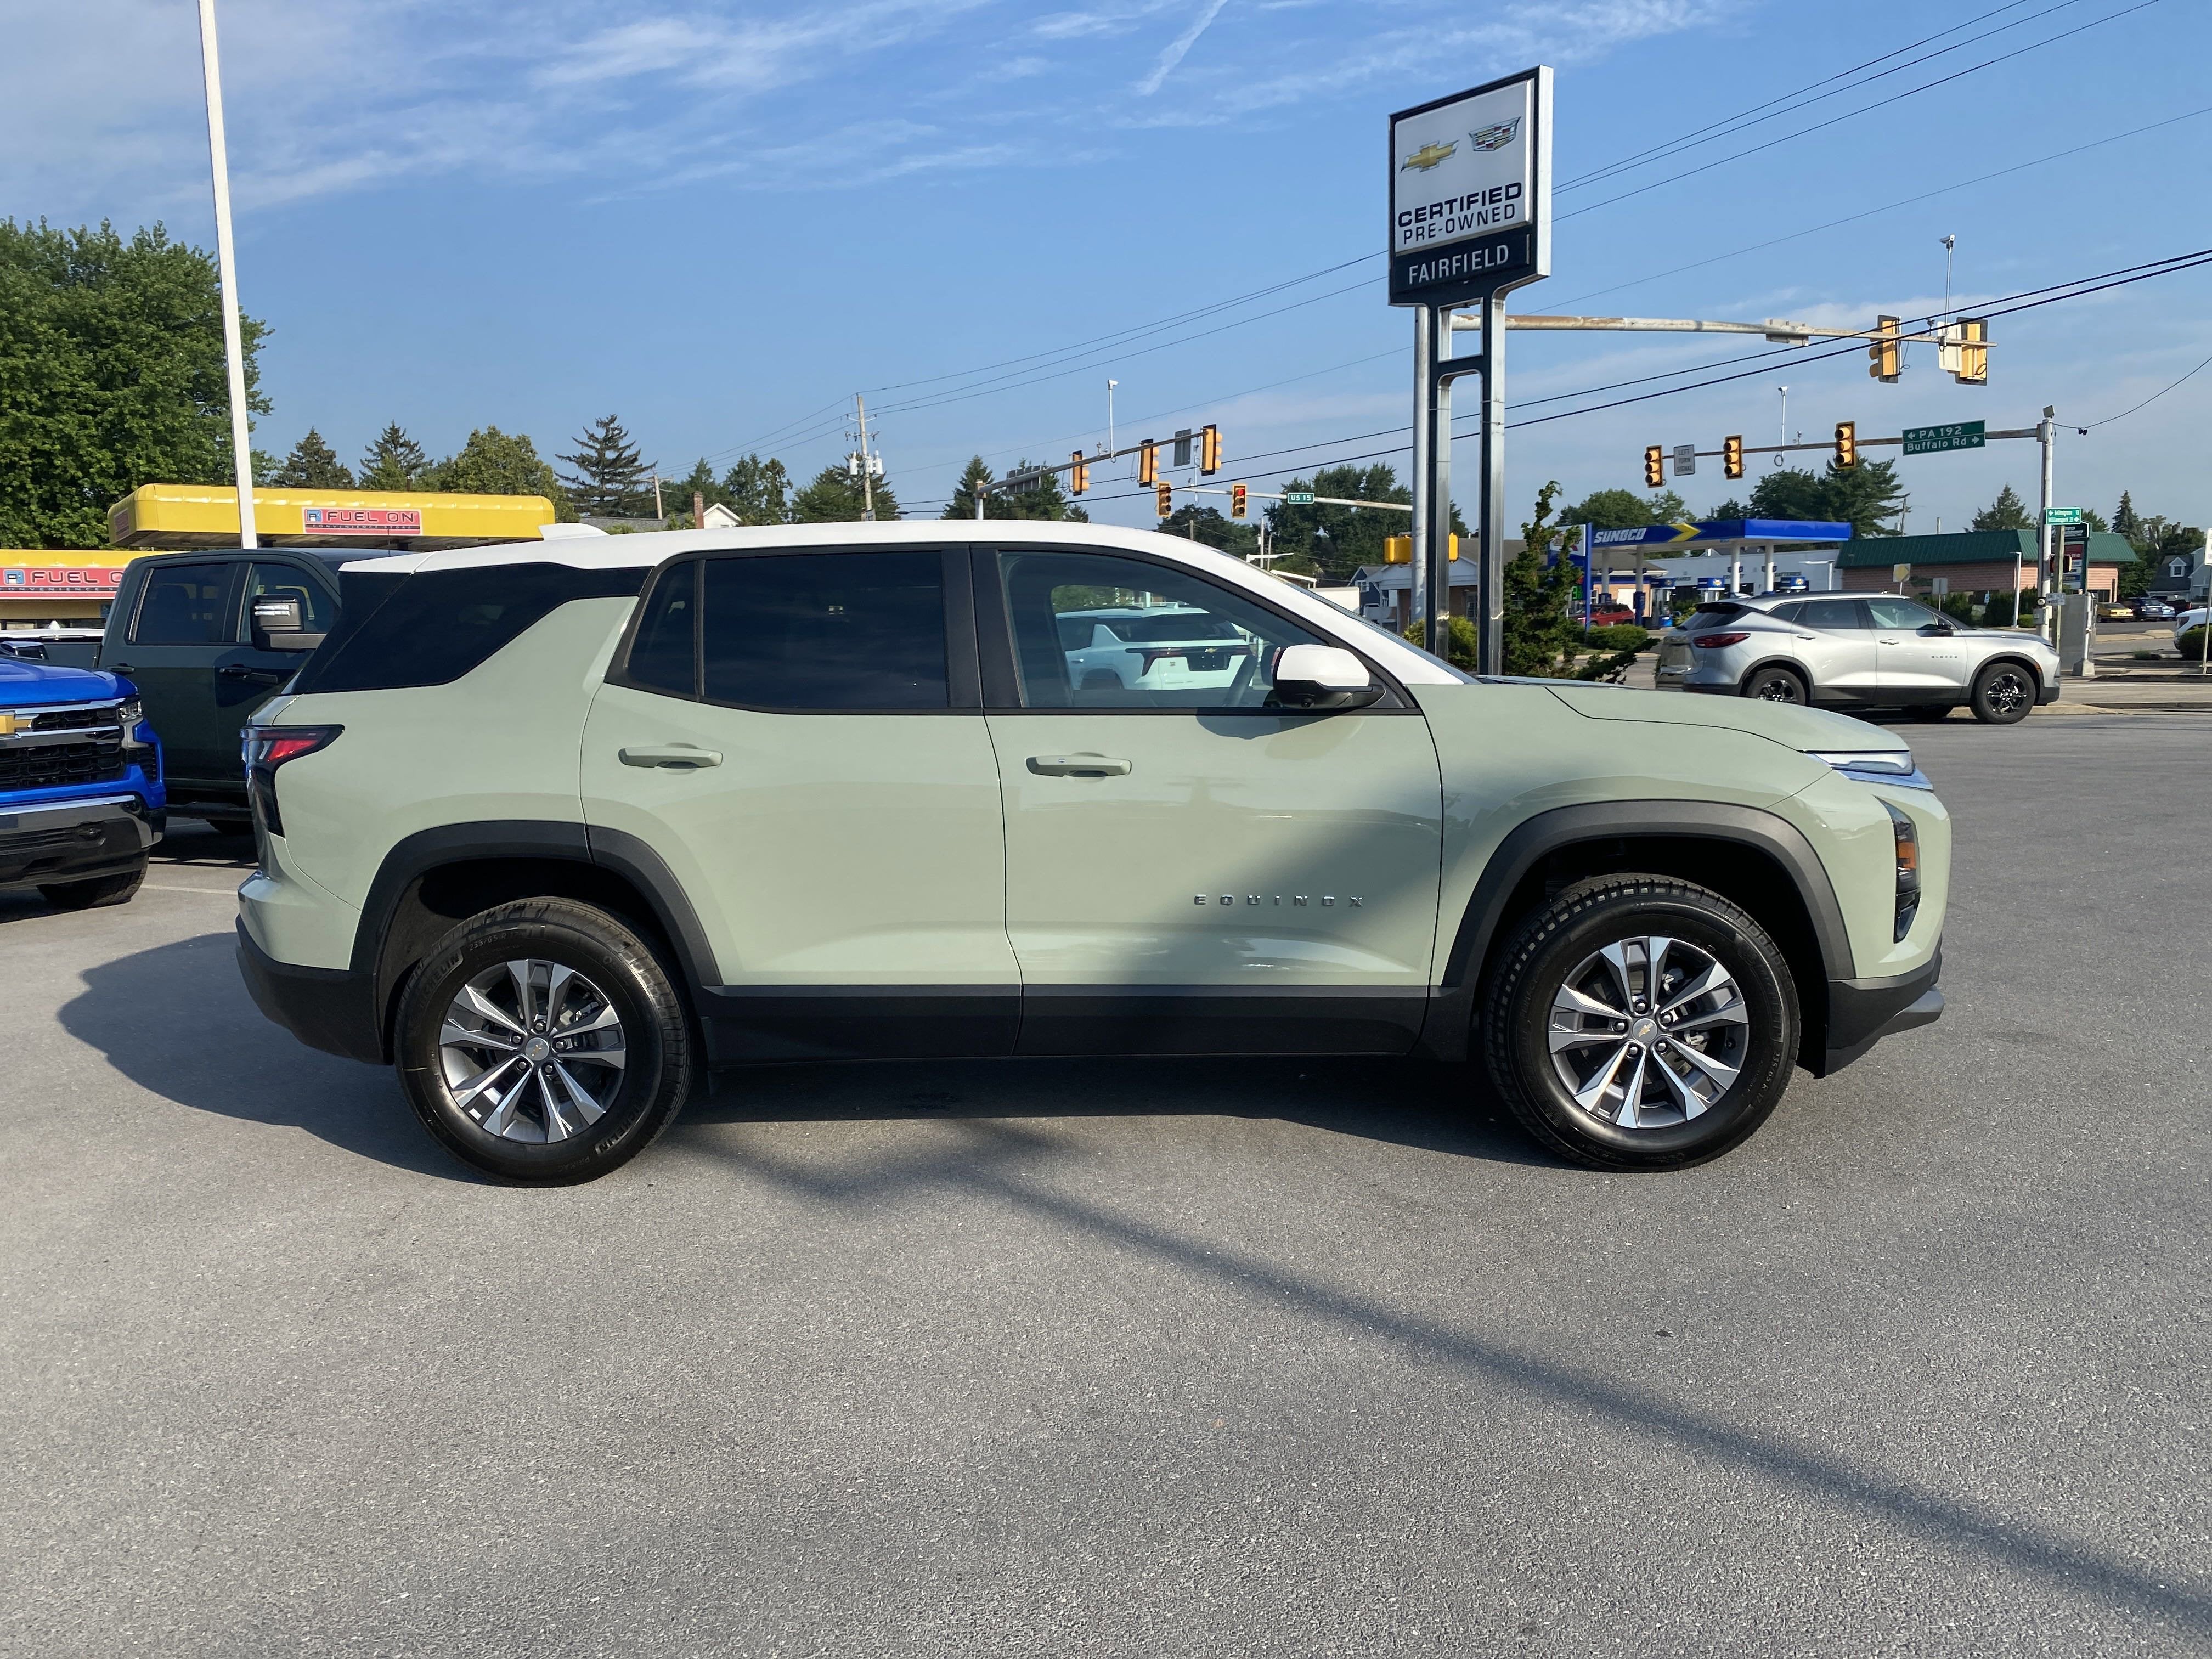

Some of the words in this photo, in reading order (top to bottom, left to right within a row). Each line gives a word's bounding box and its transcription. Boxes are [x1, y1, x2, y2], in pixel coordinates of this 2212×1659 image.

[1398, 182, 1522, 227] CERTIFIED
[1404, 203, 1515, 245] PRE-OWNED
[1408, 244, 1509, 285] FAIRFIELD
[1919, 430, 1936, 439] PA
[1940, 426, 1962, 436] 192
[1907, 440, 1948, 452] Buffalo
[1953, 437, 1967, 447] Rd
[327, 511, 378, 522] FUEL
[387, 512, 414, 522] ON
[1593, 528, 1647, 543] SUNOCO
[31, 571, 98, 583] FUEL
[1193, 895, 1363, 906] EQUINOX
